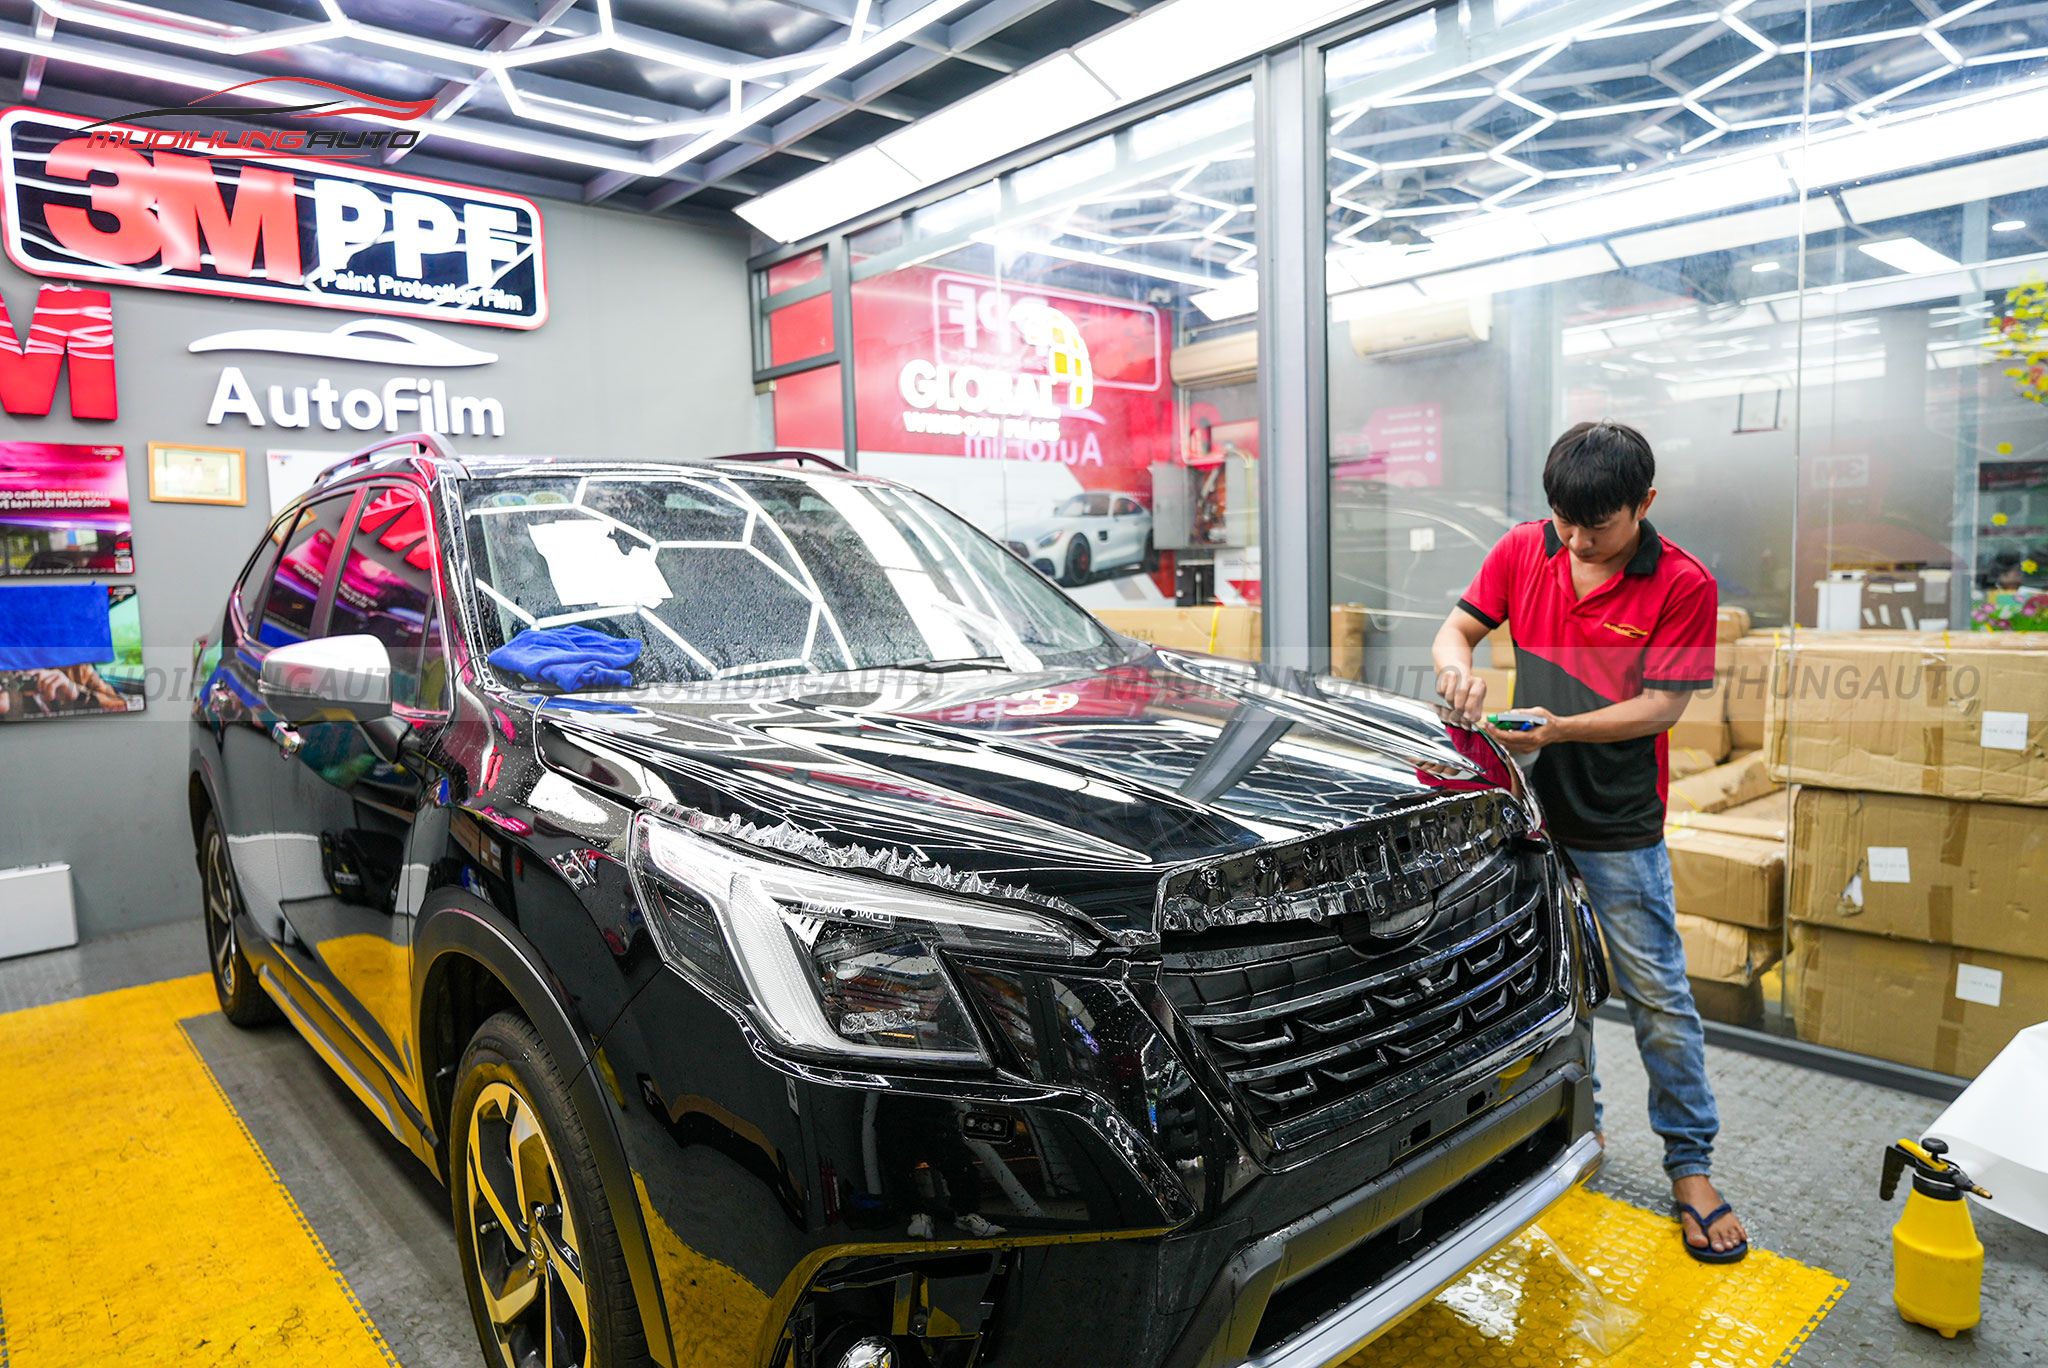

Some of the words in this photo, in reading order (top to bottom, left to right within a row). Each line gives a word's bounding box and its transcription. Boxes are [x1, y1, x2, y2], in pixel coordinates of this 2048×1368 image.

[43, 137, 304, 286] 3M
[314, 178, 518, 287] PPF
[320, 270, 376, 294] Paint
[379, 275, 481, 307] Protection
[483, 286, 523, 311] Film
[206, 367, 505, 436] AutoFilm
[899, 359, 1062, 420] GLOBAL
